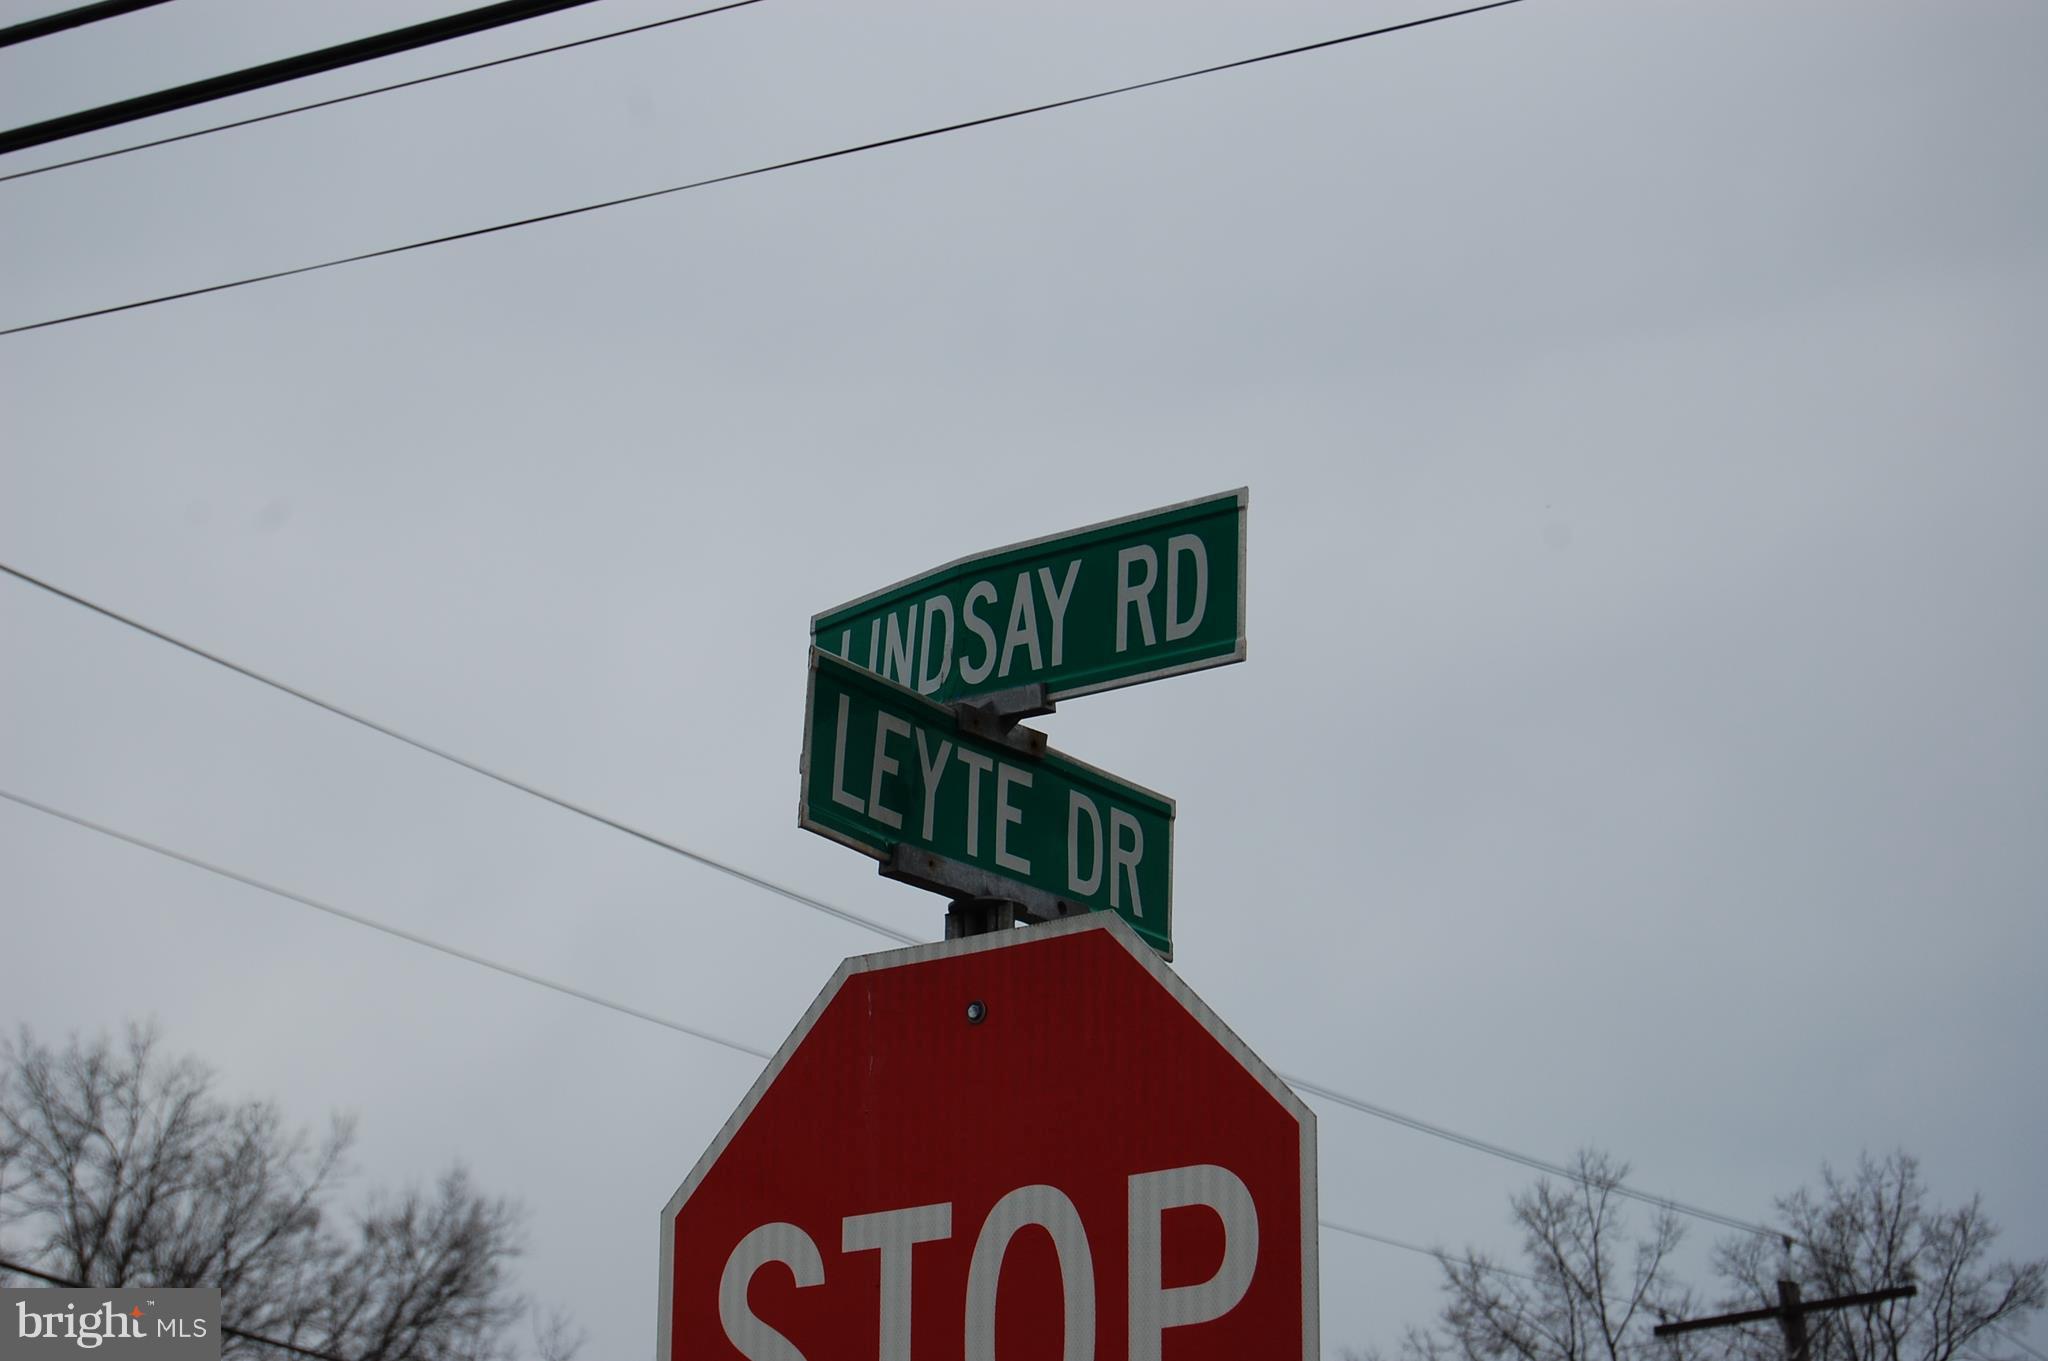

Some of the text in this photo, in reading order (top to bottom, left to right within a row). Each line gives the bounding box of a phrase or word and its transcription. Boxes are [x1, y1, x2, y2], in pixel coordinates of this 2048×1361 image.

[1116, 533, 1208, 652] RD
[832, 693, 1144, 918] LEYTE DR
